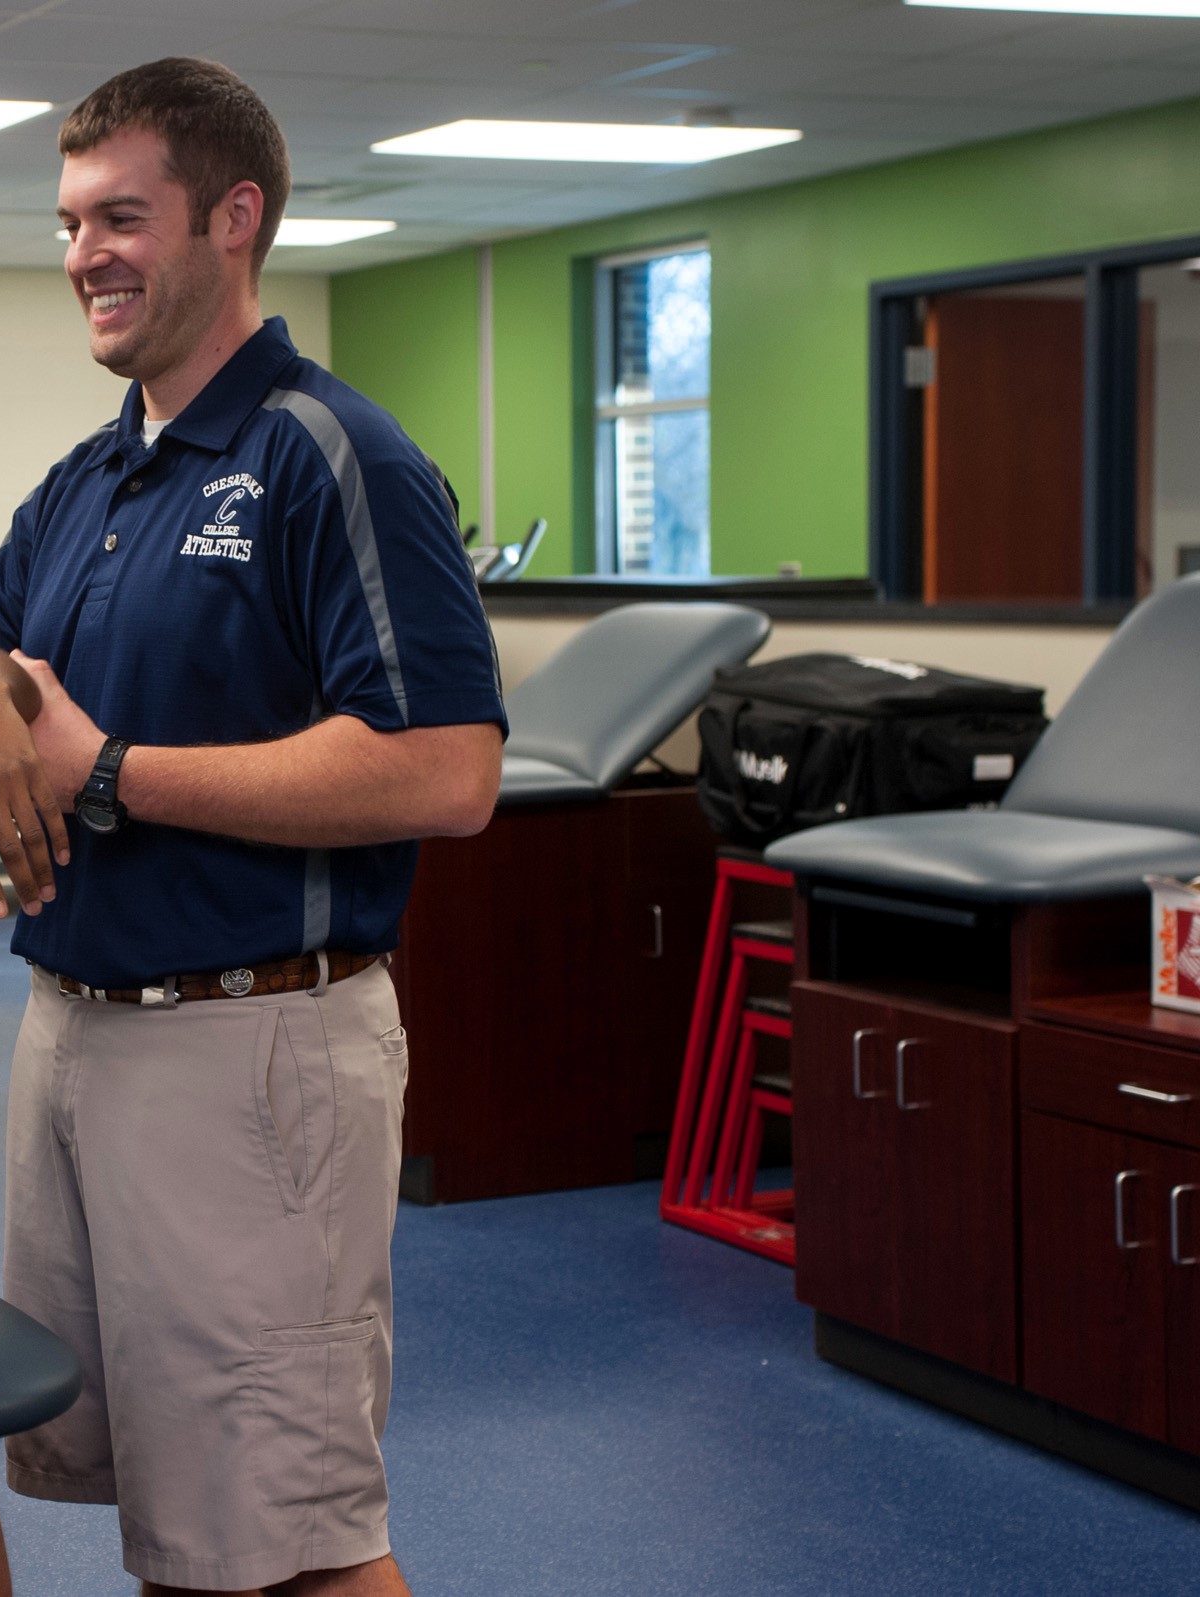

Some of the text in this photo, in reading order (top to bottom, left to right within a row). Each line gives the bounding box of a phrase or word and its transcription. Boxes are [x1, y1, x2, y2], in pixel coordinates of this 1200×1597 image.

[215, 488, 245, 524] C
[202, 524, 240, 536] COLLEGE
[180, 534, 252, 561] ATHLETICS
